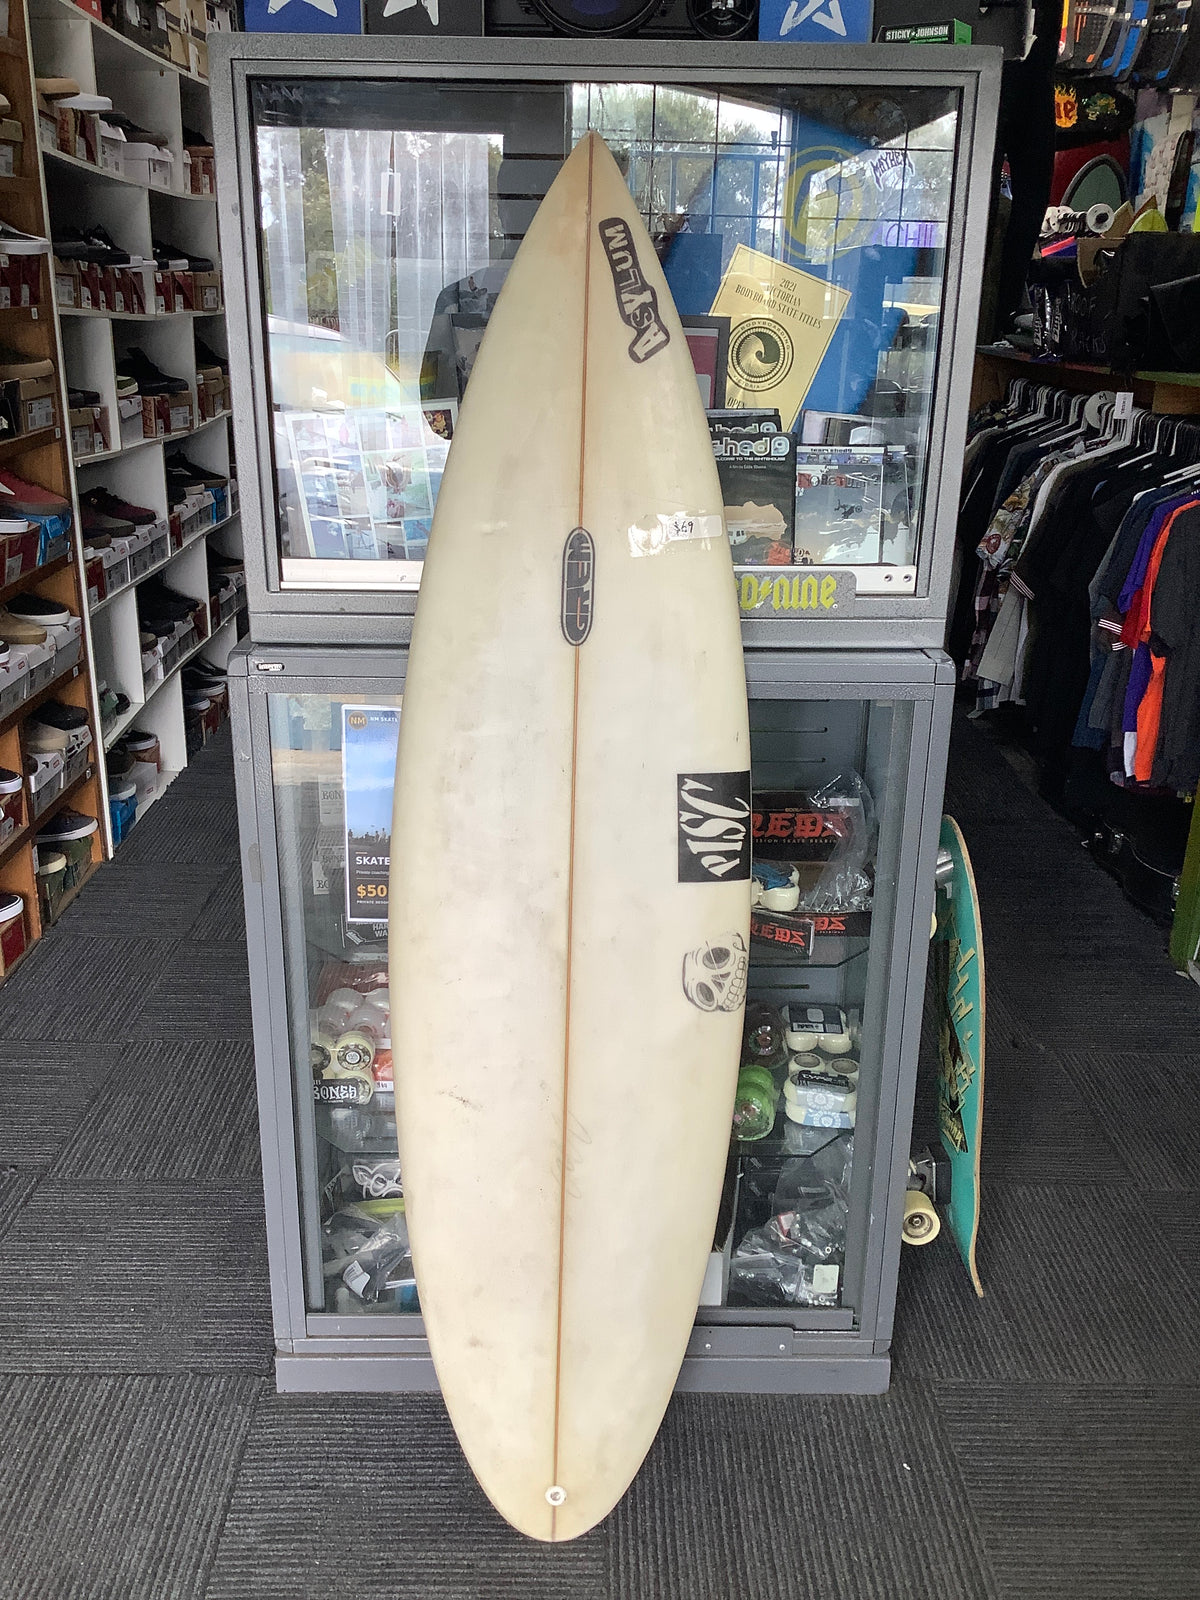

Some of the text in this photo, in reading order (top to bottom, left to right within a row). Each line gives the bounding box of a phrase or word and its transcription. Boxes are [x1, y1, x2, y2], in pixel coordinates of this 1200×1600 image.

[886, 25, 949, 41] STICKY JOHNSON
[603, 222, 670, 362] ASYLUM
[779, 277, 798, 292] 2021
[767, 284, 801, 308] VICTORIAN
[735, 284, 823, 330] BODYBOARD STATE TITLES
[740, 320, 791, 351] BODYBOARDING
[673, 521, 695, 537] $69
[350, 717, 366, 725] NM
[355, 856, 390, 866] SKATE
[356, 884, 388, 898] $50
